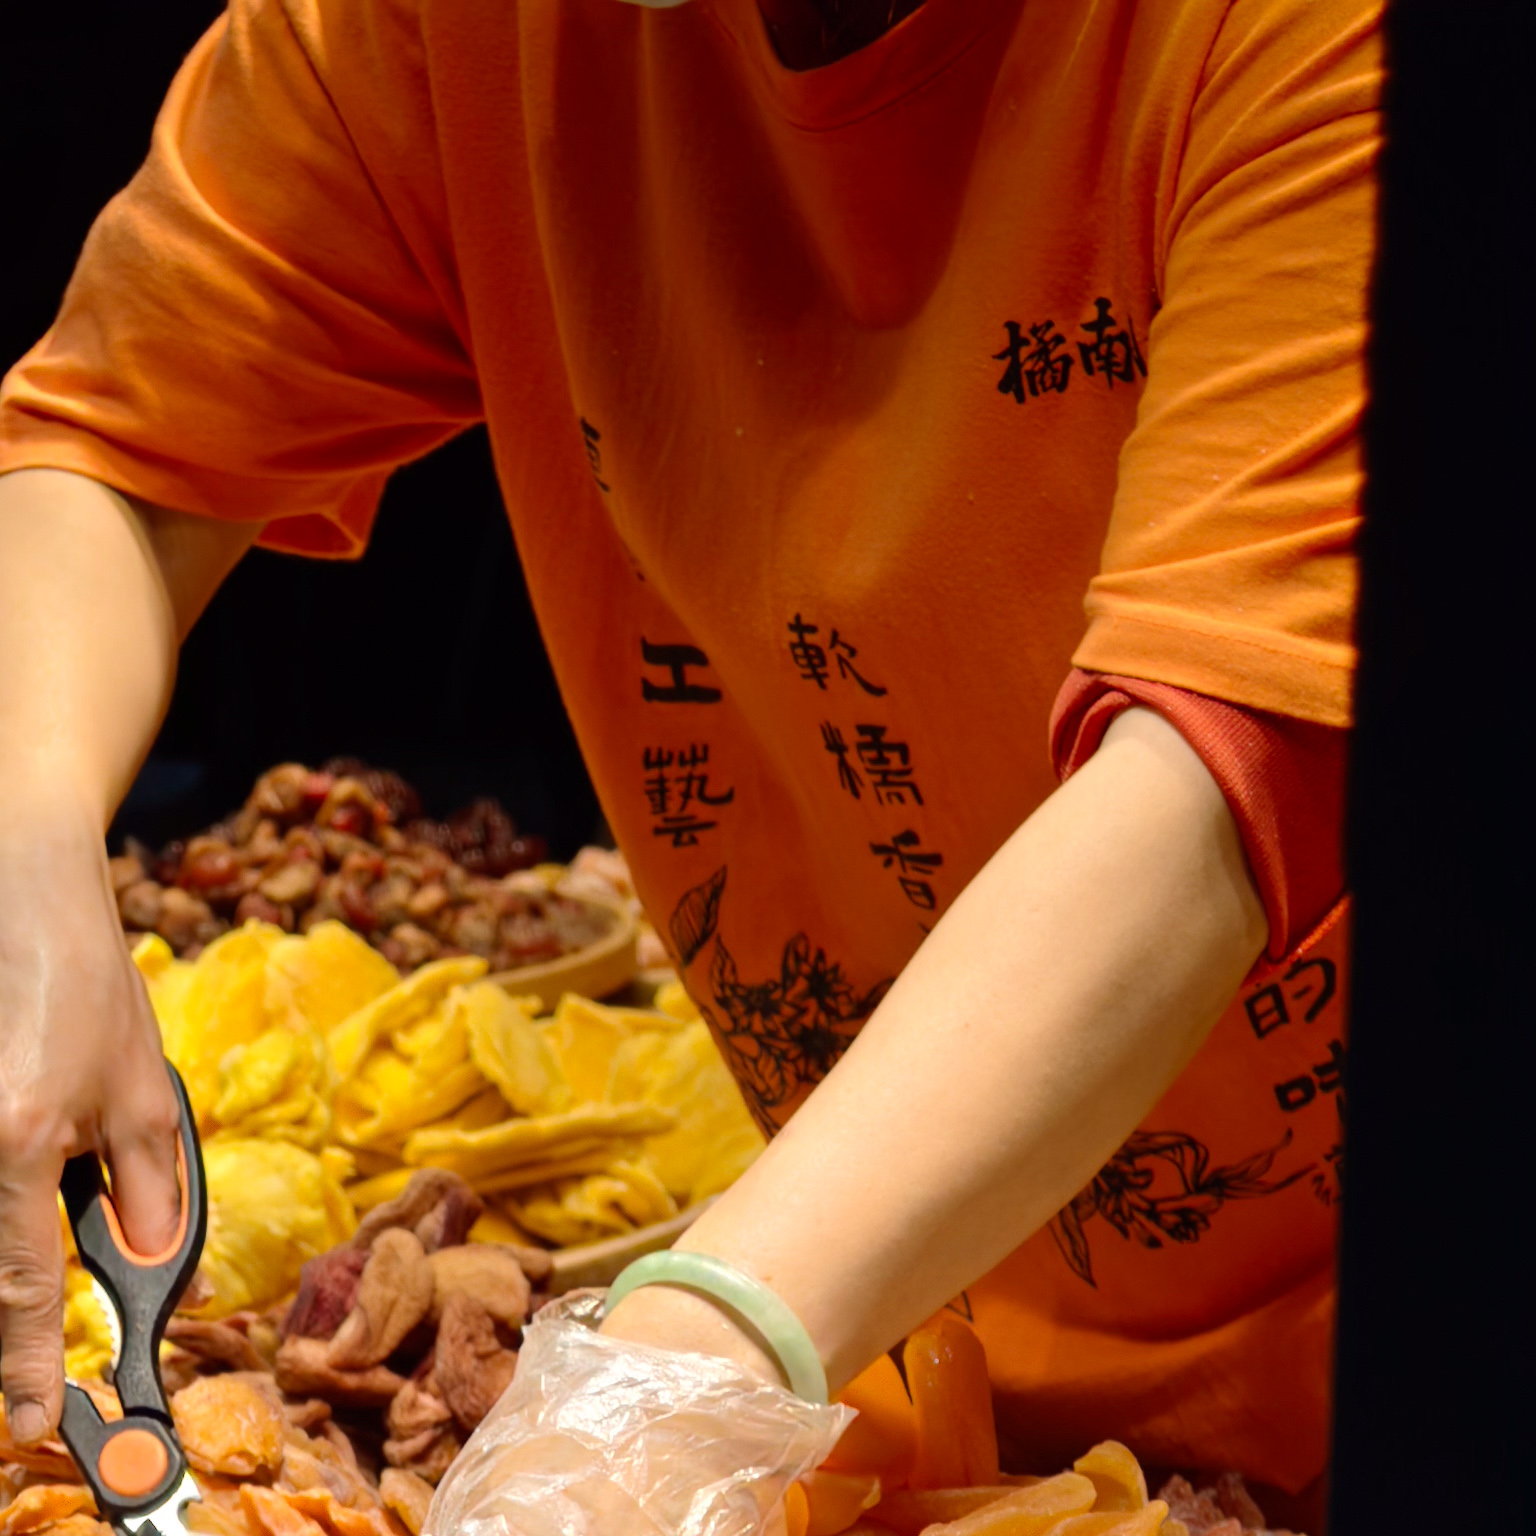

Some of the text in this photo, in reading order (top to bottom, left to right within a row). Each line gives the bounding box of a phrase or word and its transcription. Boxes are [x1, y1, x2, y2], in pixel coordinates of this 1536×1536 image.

[992, 297, 1148, 404] 橘南
[787, 612, 943, 934] 軟糯香
